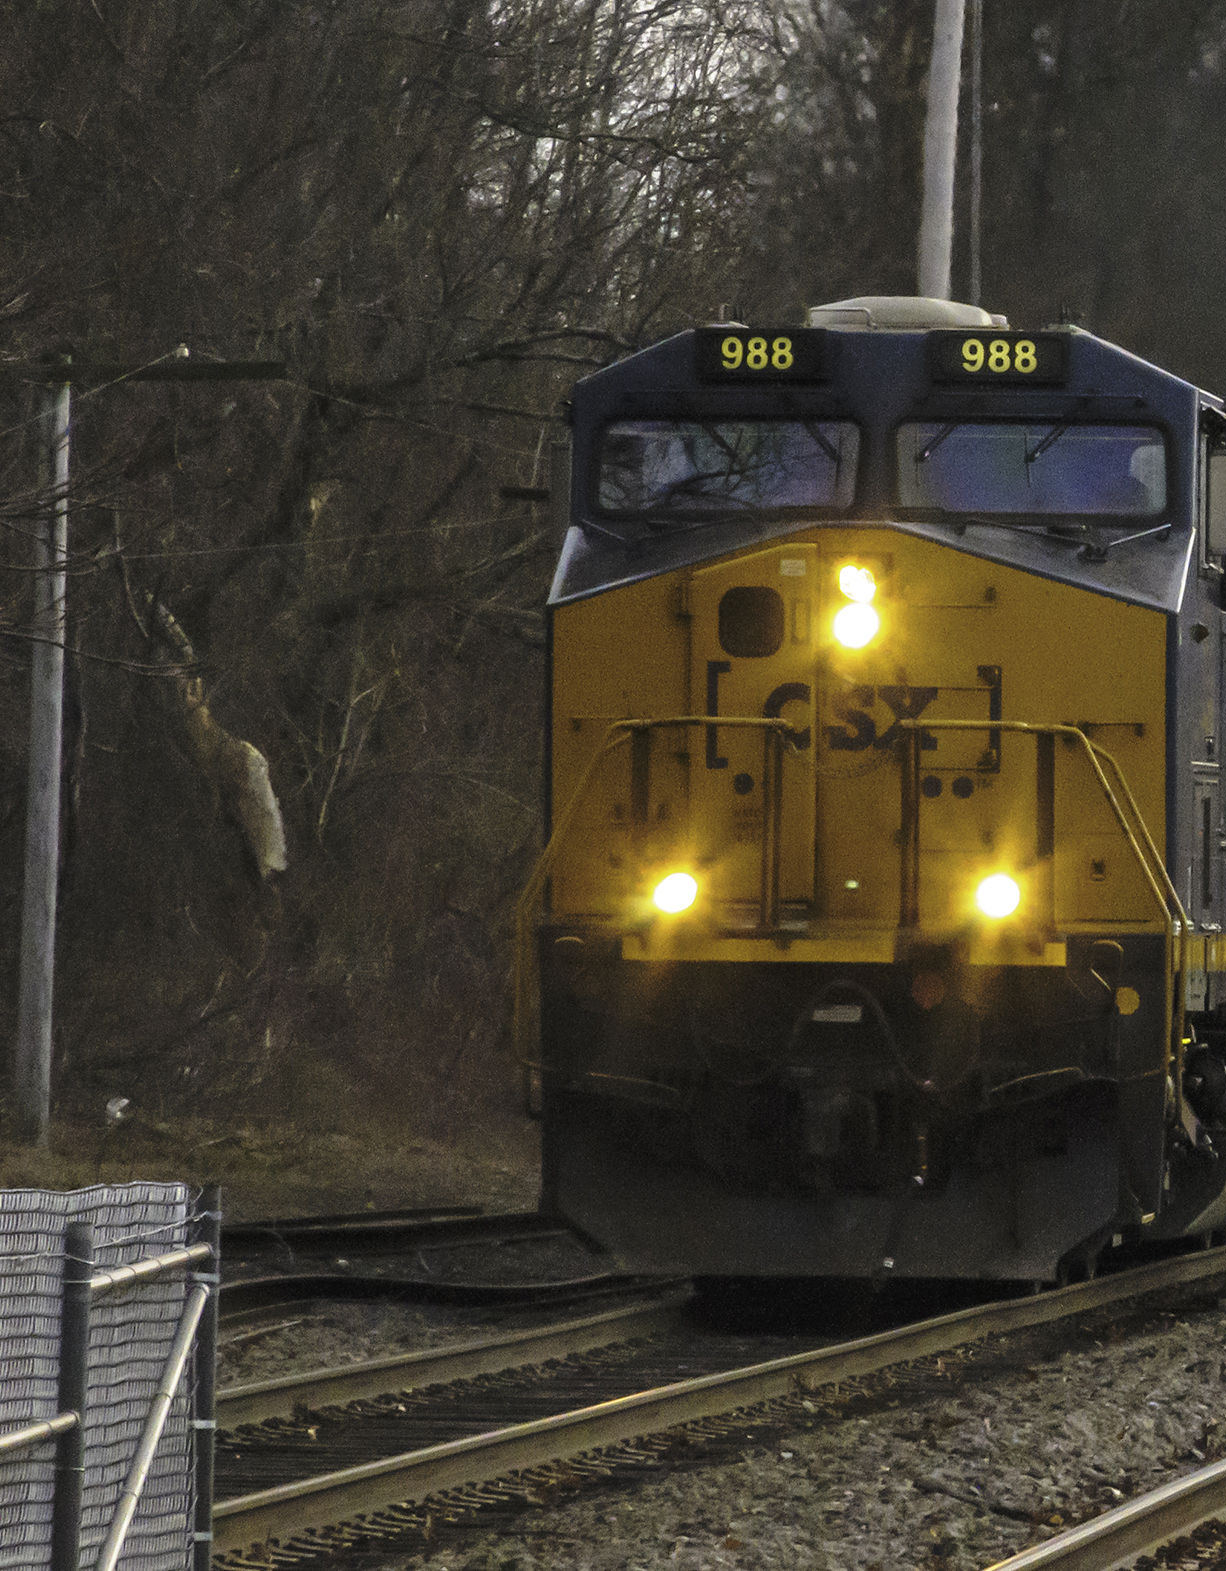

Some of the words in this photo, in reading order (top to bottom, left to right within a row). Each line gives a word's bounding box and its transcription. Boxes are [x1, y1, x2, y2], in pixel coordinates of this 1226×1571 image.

[721, 336, 794, 370] 988
[962, 338, 1038, 373] 988
[763, 682, 939, 751] CSX
